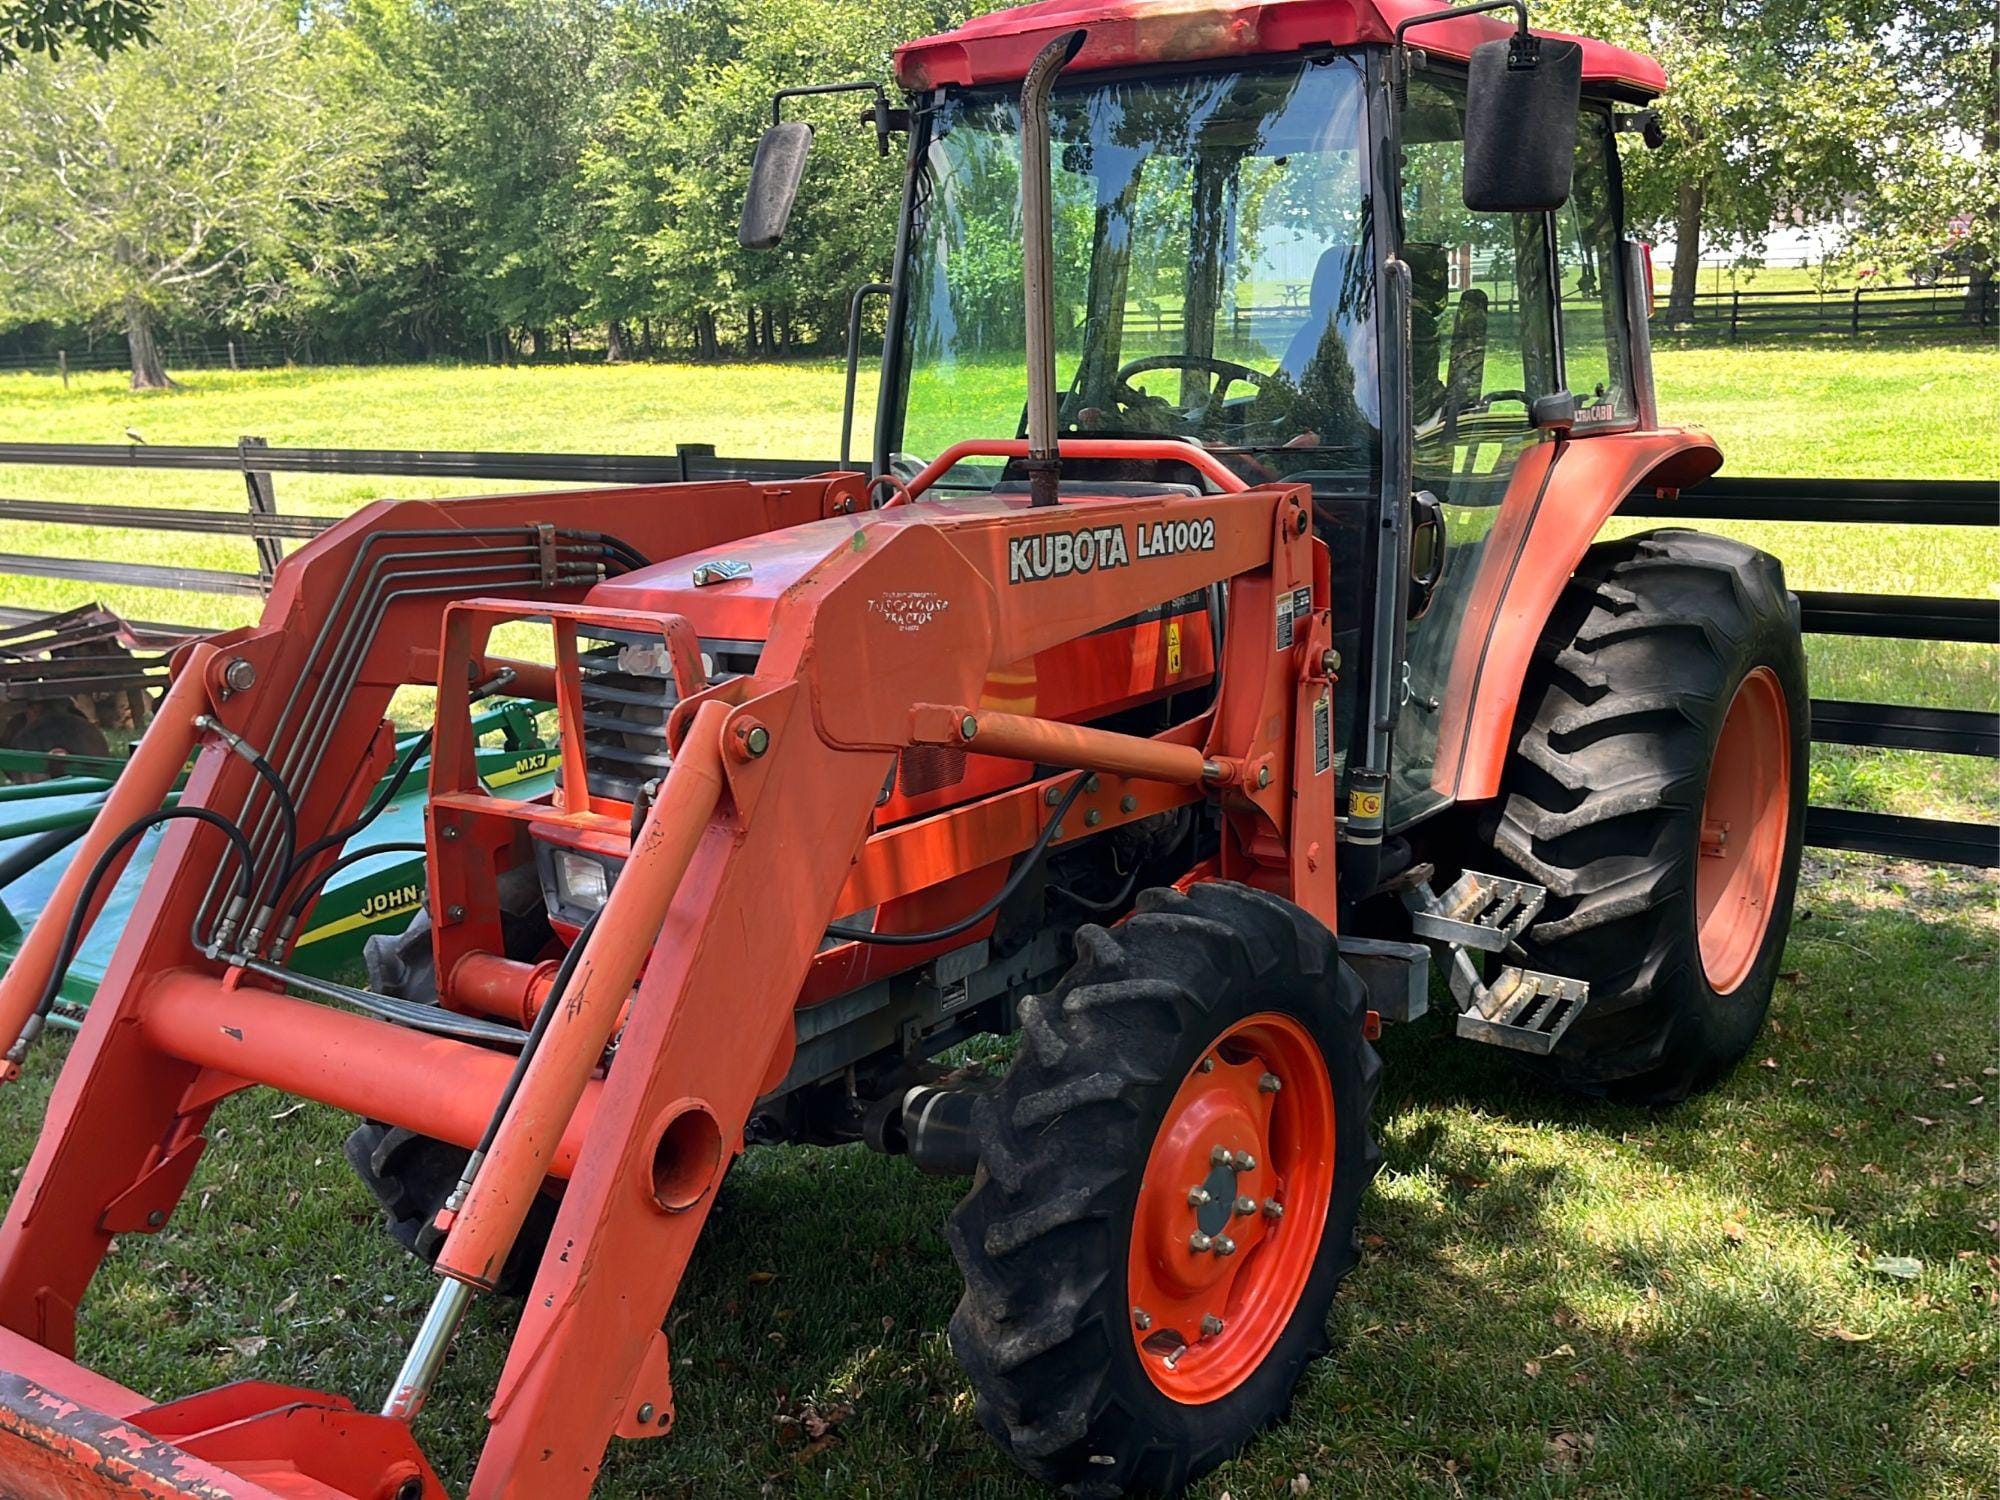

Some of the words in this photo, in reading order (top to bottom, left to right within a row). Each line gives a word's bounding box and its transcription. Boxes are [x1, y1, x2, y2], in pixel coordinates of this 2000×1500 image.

[1009, 524, 1129, 585] KUBOTA
[1137, 517, 1215, 559] LA1002
[516, 753, 547, 774] MX7
[361, 884, 418, 917] JOHN
